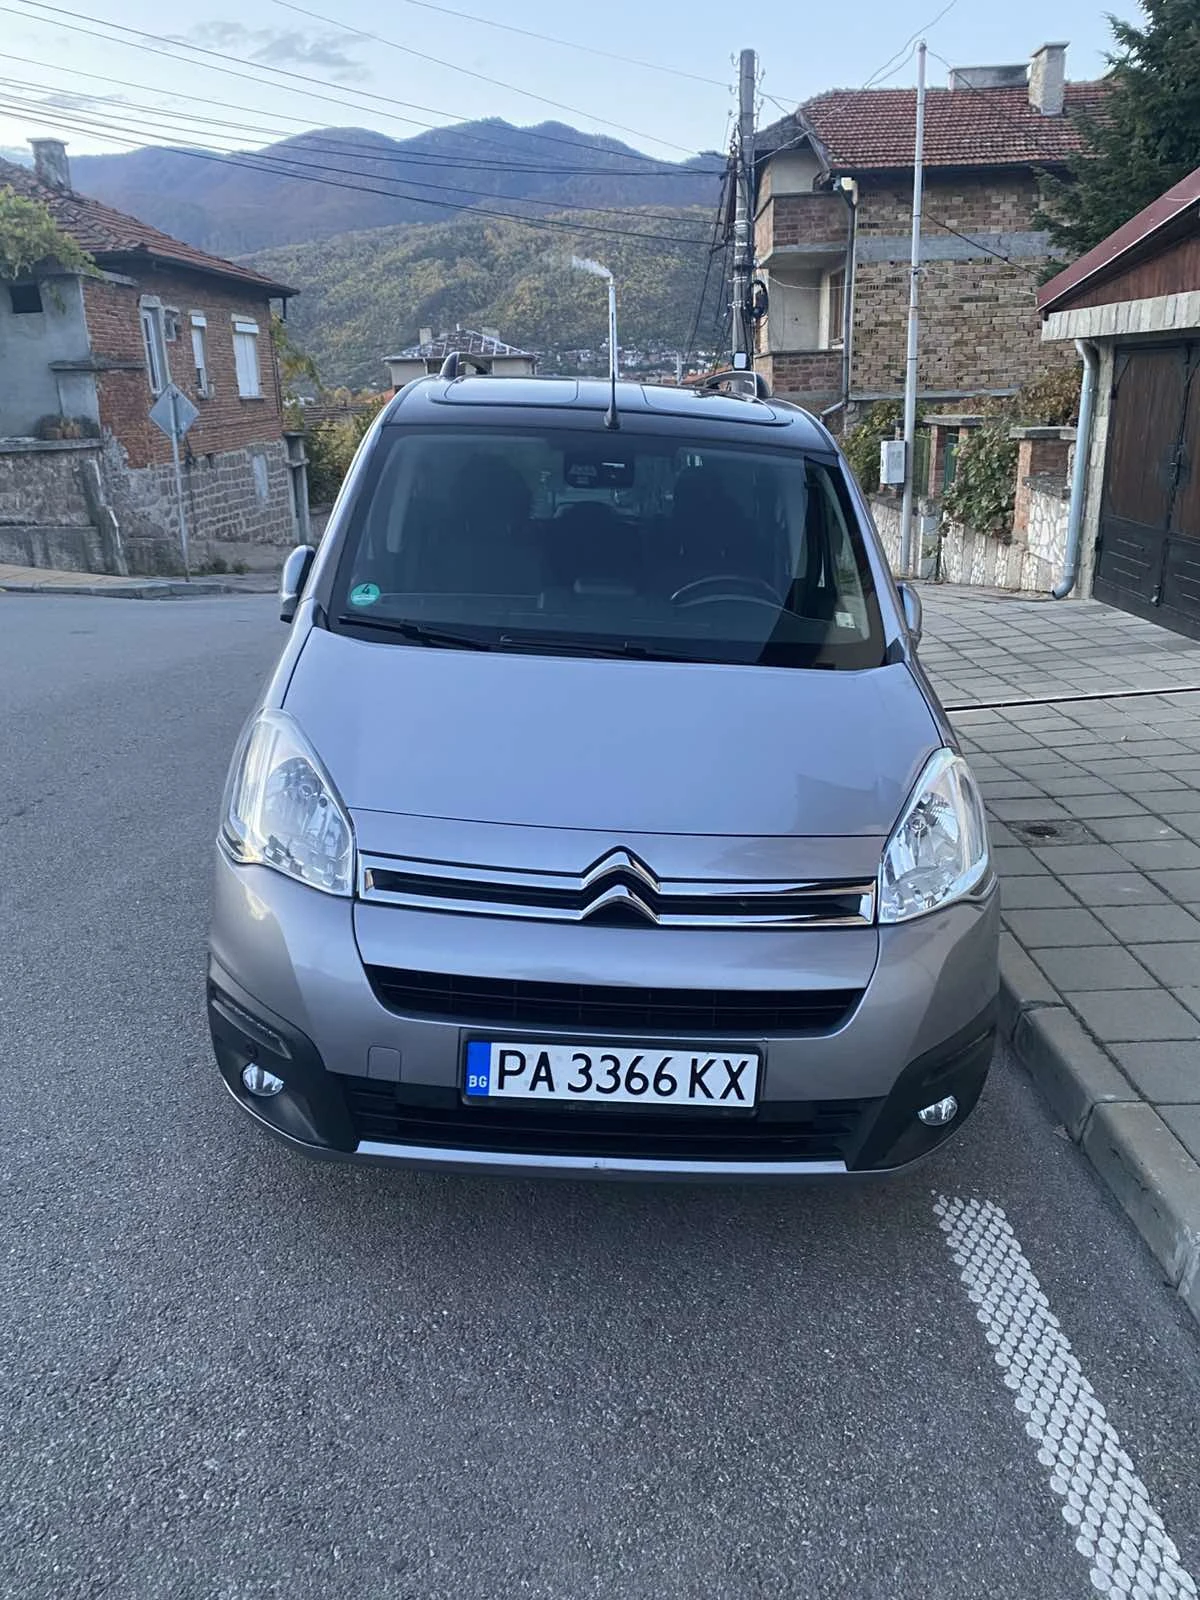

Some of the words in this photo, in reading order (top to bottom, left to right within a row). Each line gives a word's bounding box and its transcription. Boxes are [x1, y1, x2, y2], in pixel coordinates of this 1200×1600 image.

[361, 583, 371, 595] 4
[468, 1074, 488, 1088] BG
[497, 1049, 555, 1092] PA
[567, 1052, 678, 1097] 3366
[688, 1057, 749, 1101] KX
